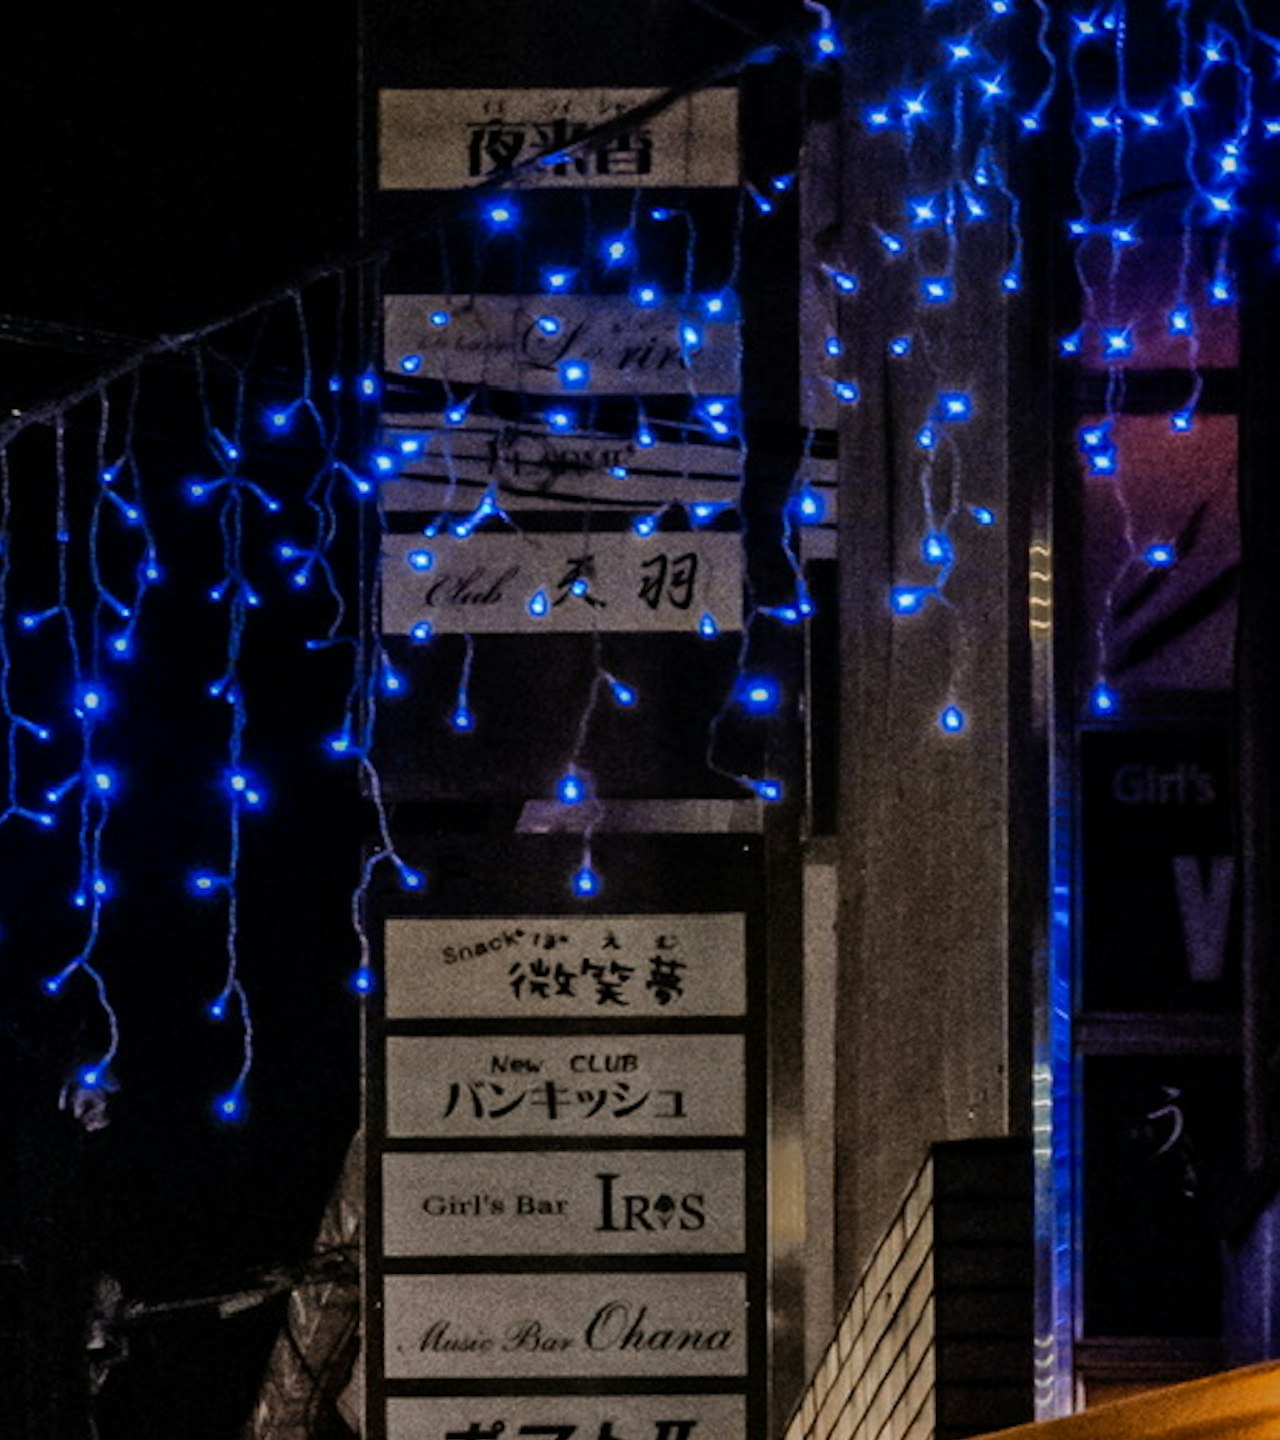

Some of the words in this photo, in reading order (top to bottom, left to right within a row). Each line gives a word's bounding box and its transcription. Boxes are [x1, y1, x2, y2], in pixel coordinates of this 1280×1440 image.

[425, 567, 519, 608] Club
[442, 928, 525, 966] Snack
[508, 954, 687, 1006] 微笑夢
[490, 1053, 545, 1074] New
[570, 1053, 639, 1074] CLUB
[442, 1080, 688, 1121] バンキッシュ
[421, 1194, 506, 1217] Girl's
[516, 1195, 570, 1216] Bar
[396, 1318, 494, 1357] Music
[500, 1319, 574, 1353] Bar
[584, 1298, 736, 1354] Ohana
